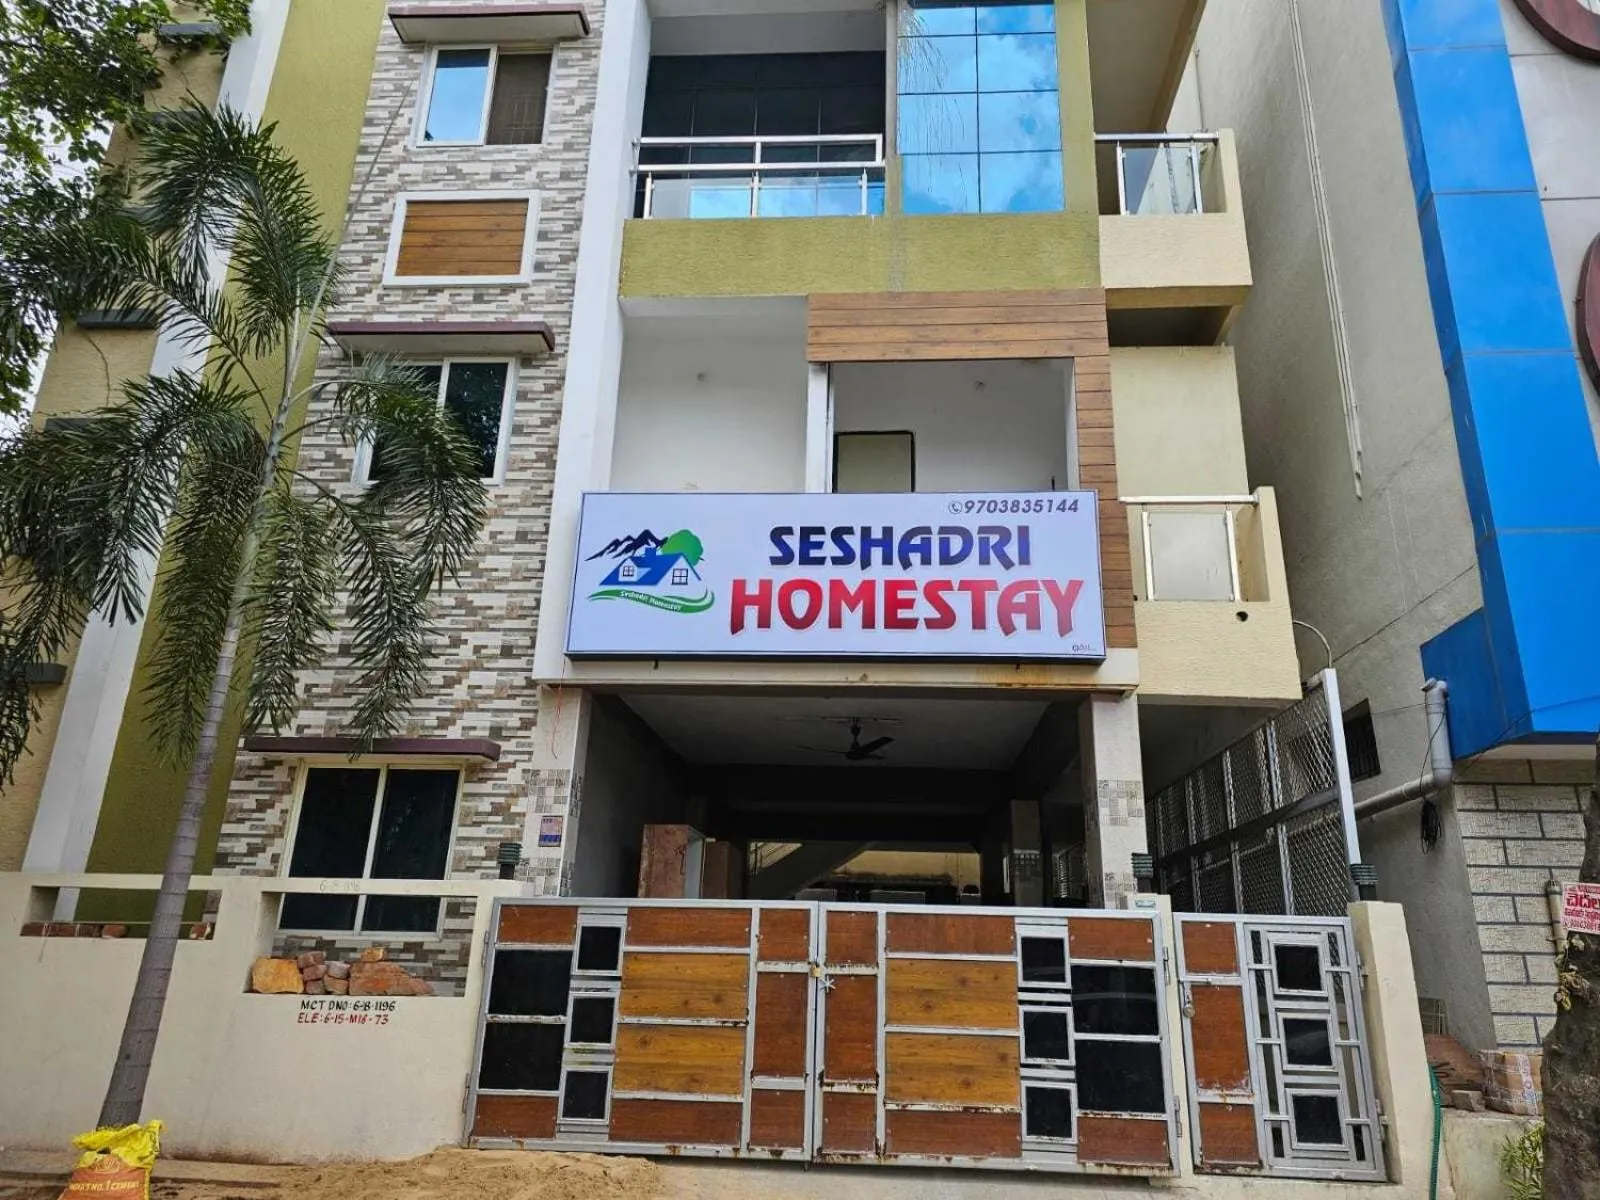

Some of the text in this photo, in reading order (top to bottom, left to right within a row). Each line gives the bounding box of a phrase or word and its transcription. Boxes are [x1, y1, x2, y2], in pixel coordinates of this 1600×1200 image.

[964, 499, 1080, 514] 9703835144
[769, 525, 1031, 571] SESHADRI
[729, 578, 1085, 638] HOMESTAY
[300, 999, 325, 1011] MCT
